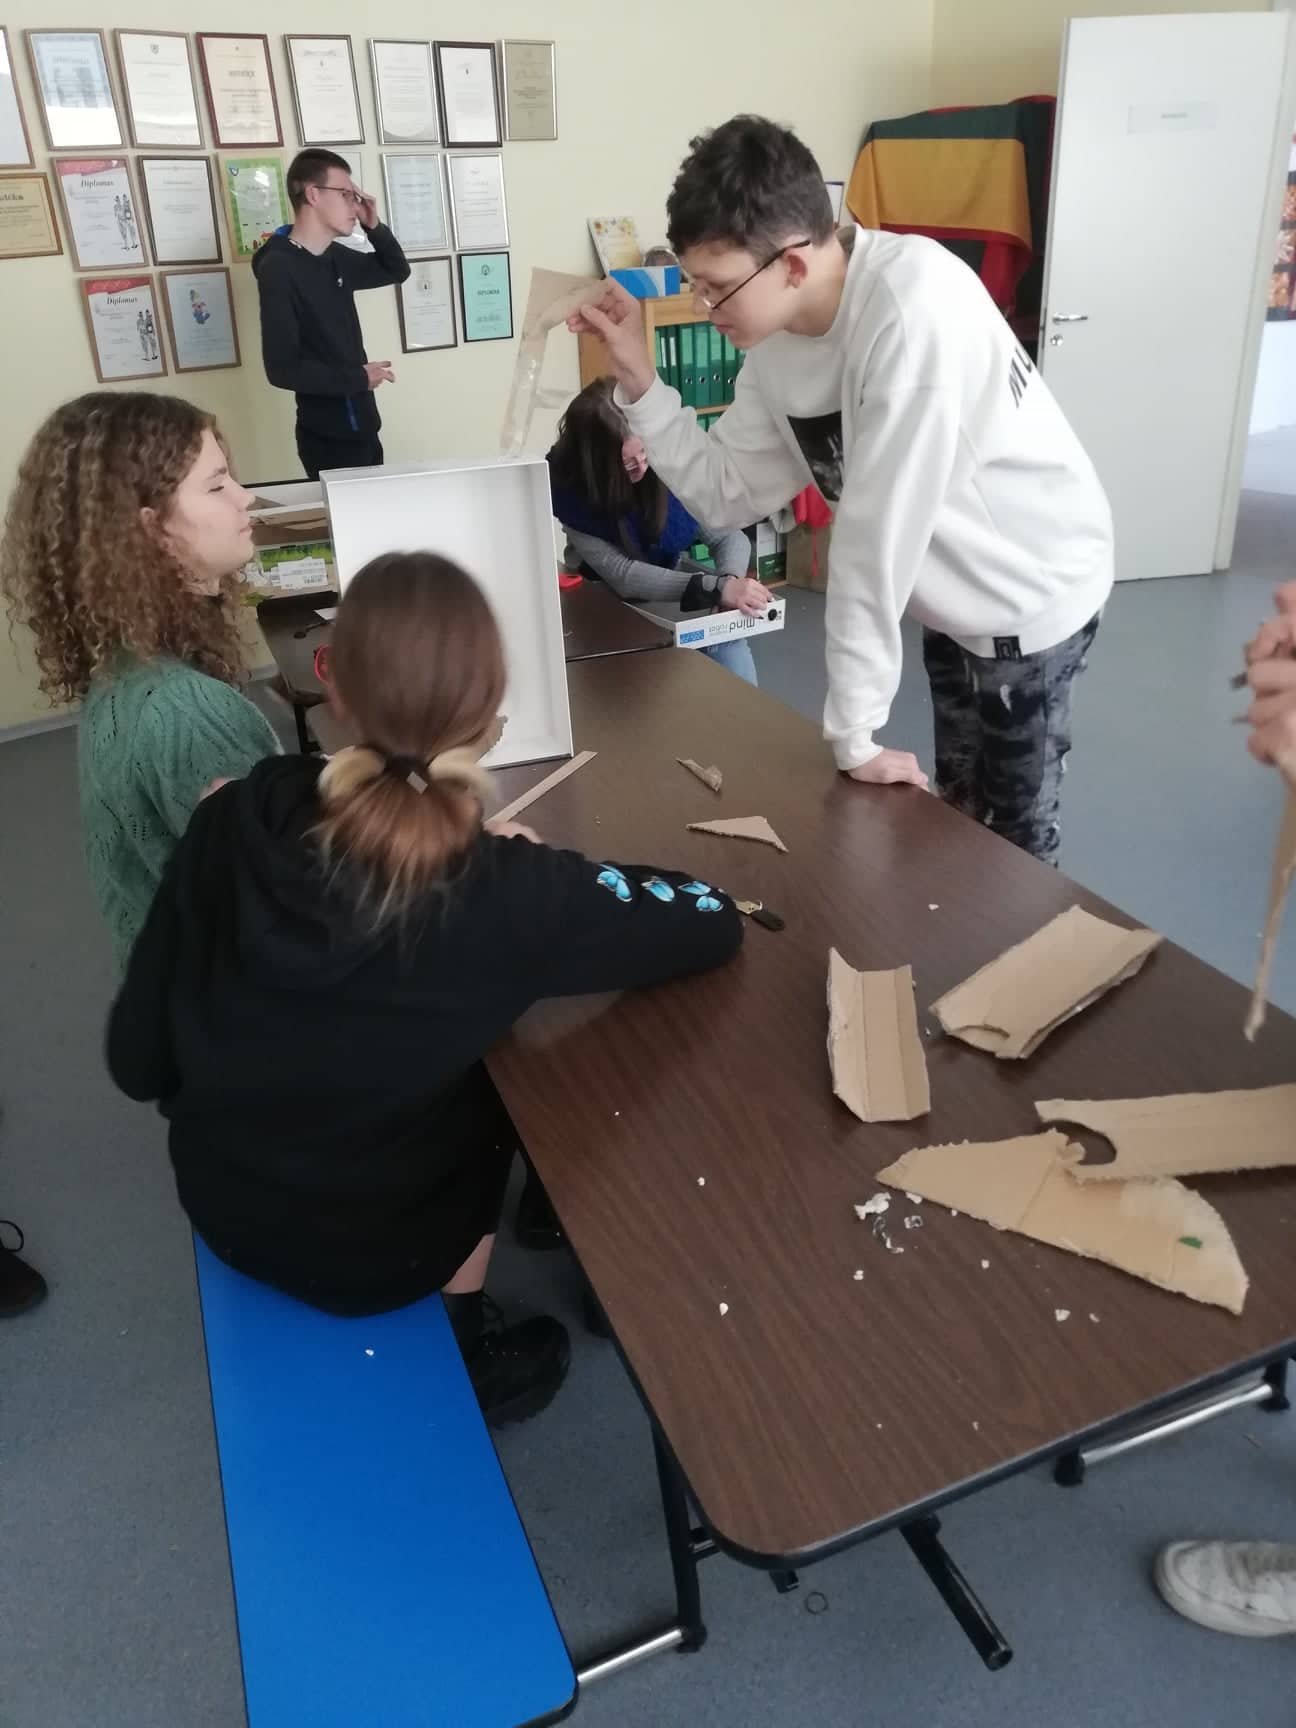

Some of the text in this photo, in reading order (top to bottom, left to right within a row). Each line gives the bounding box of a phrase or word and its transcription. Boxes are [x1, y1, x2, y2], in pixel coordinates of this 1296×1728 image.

[81, 179, 114, 189] Diplomas
[106, 296, 138, 305] Diplomas
[729, 616, 755, 633] mind
